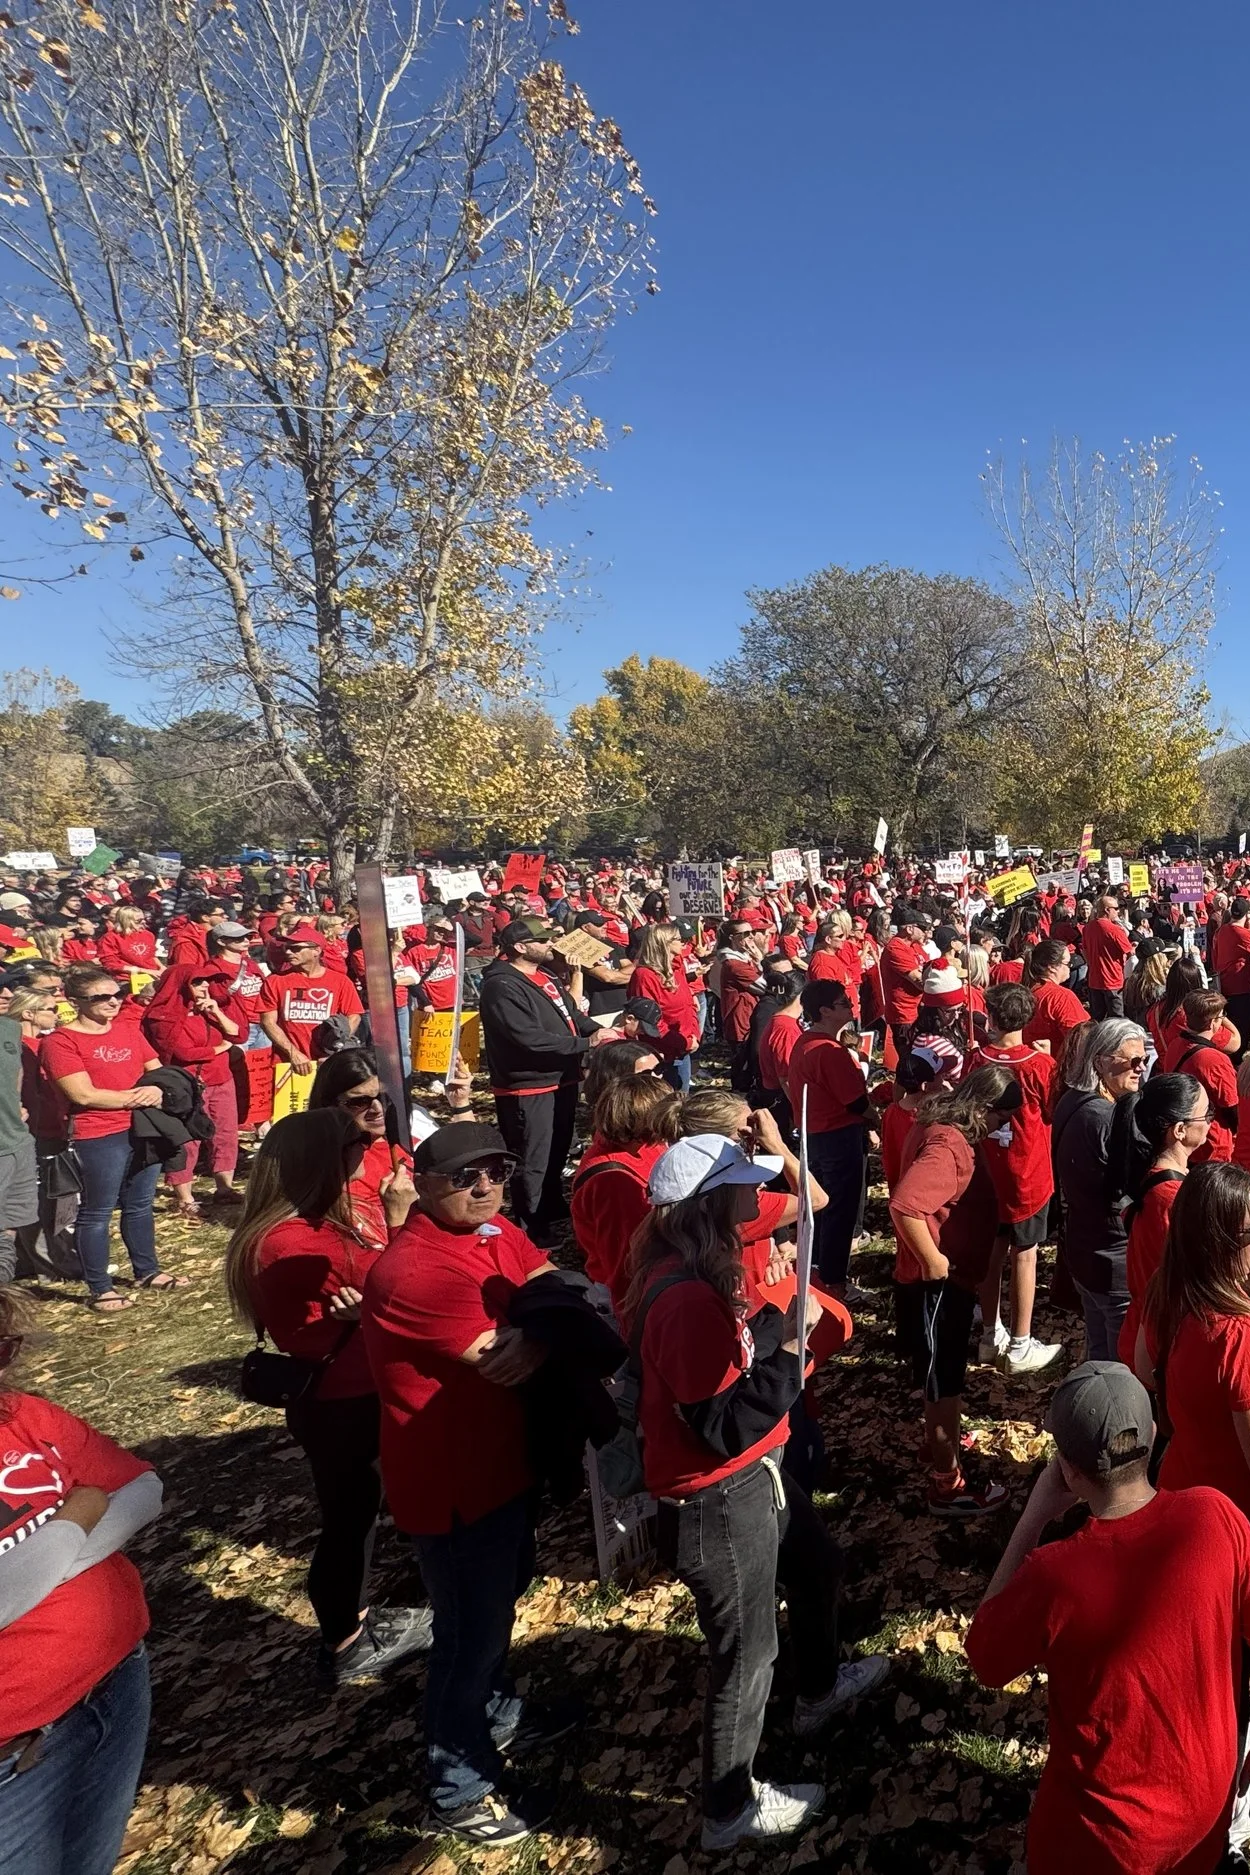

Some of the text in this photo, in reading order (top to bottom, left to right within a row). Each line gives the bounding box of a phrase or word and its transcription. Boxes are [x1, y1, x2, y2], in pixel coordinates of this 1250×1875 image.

[698, 865, 708, 879] for
[708, 865, 719, 879] the
[687, 879, 713, 892] FUTURE
[290, 1001, 328, 1011] PUBLIC
